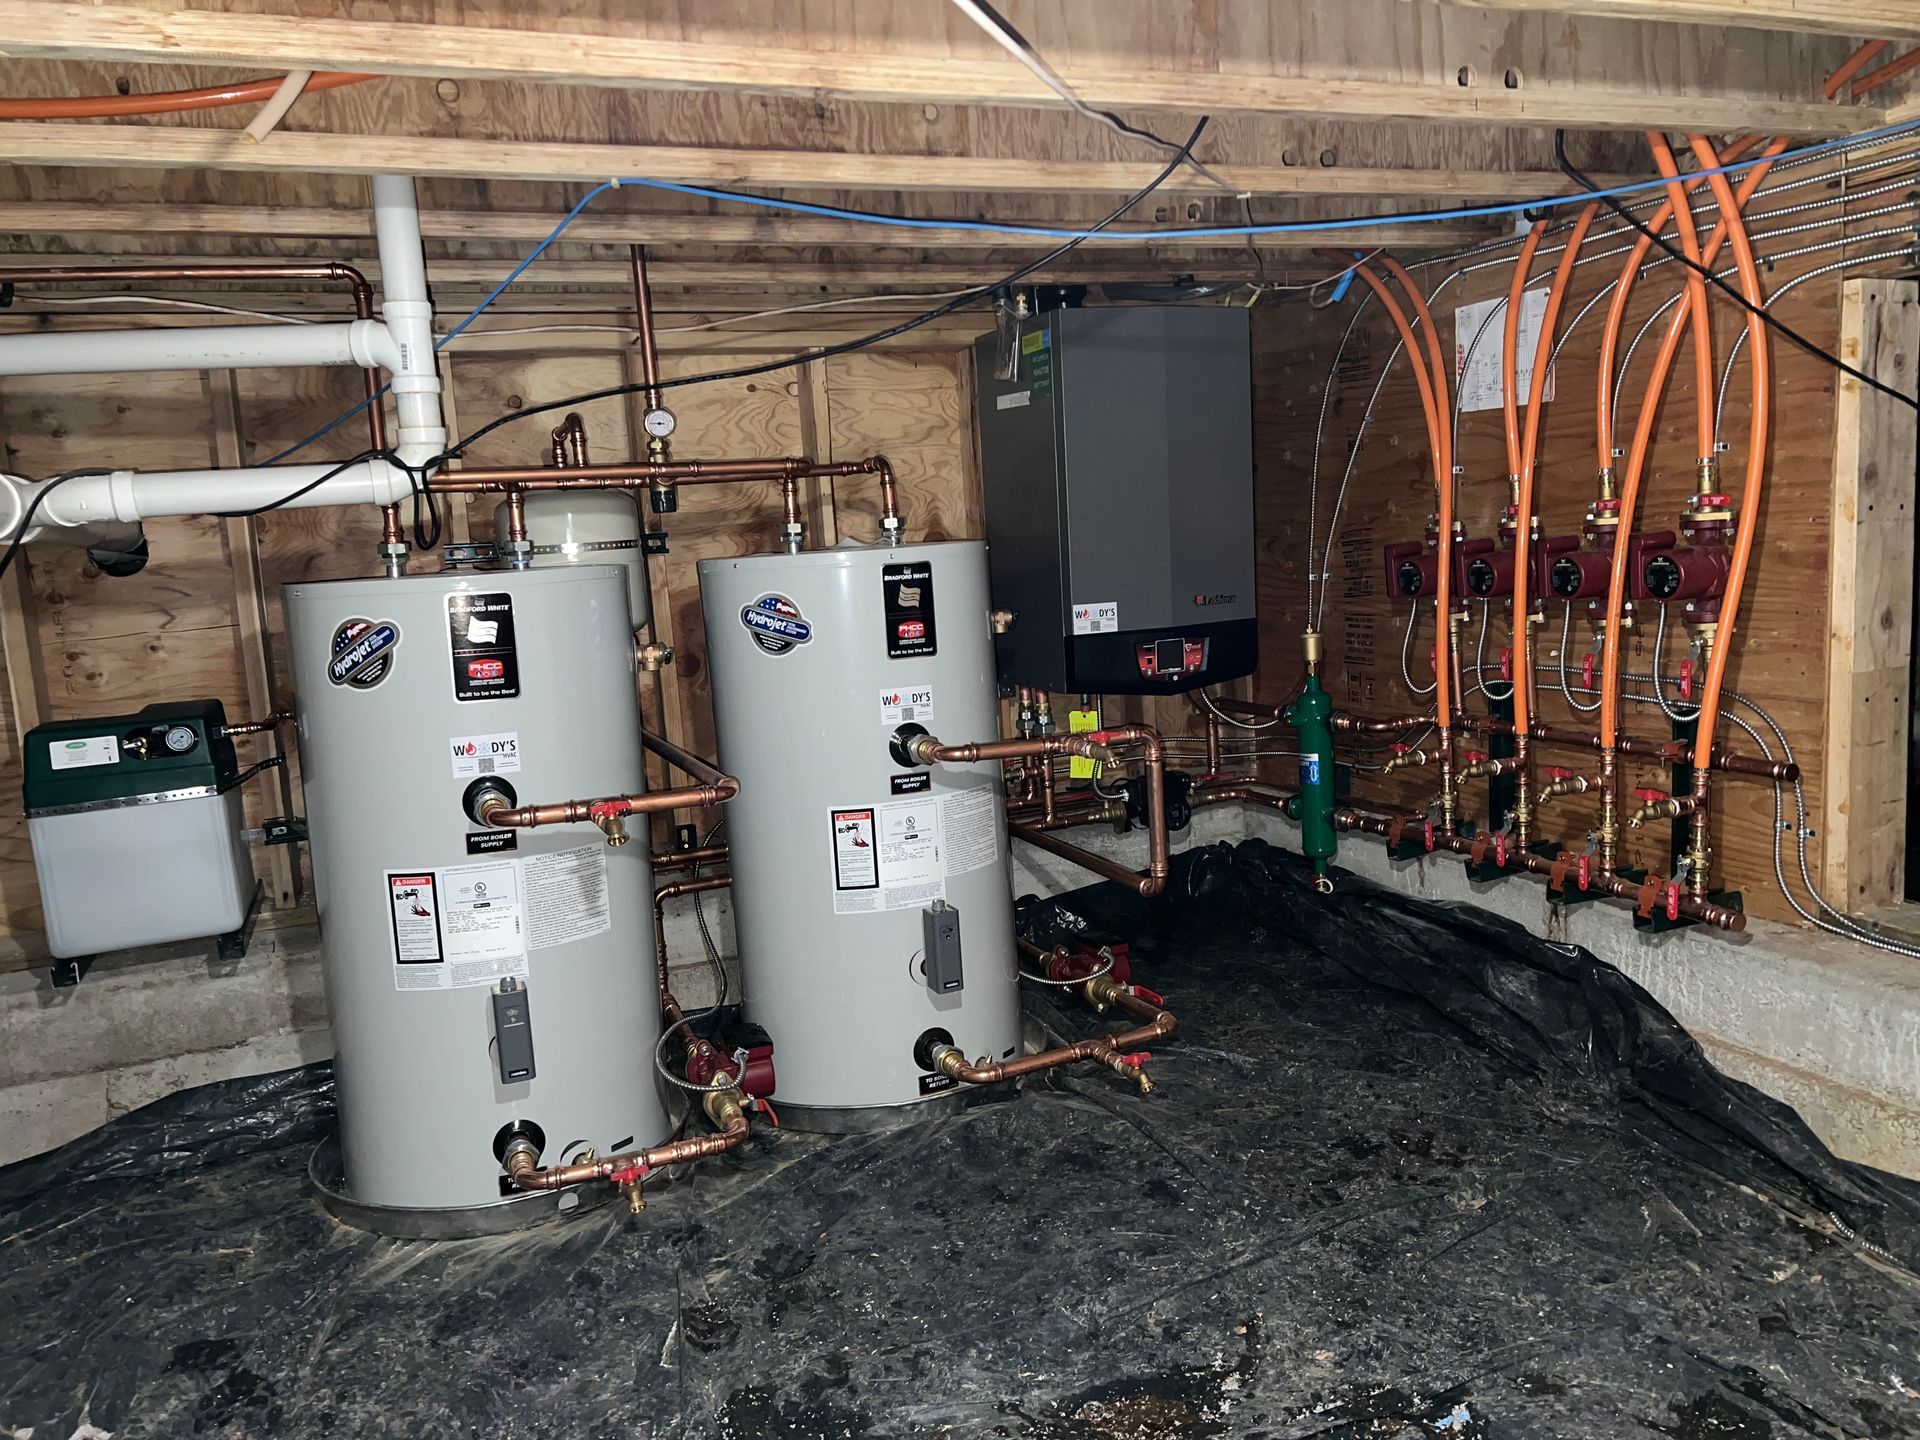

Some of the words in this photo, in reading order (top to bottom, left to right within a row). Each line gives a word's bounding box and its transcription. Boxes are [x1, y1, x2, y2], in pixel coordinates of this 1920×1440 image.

[747, 611, 787, 631] Hydrojet
[334, 641, 371, 677] Hydrojet
[929, 1079, 950, 1088] RETURN
